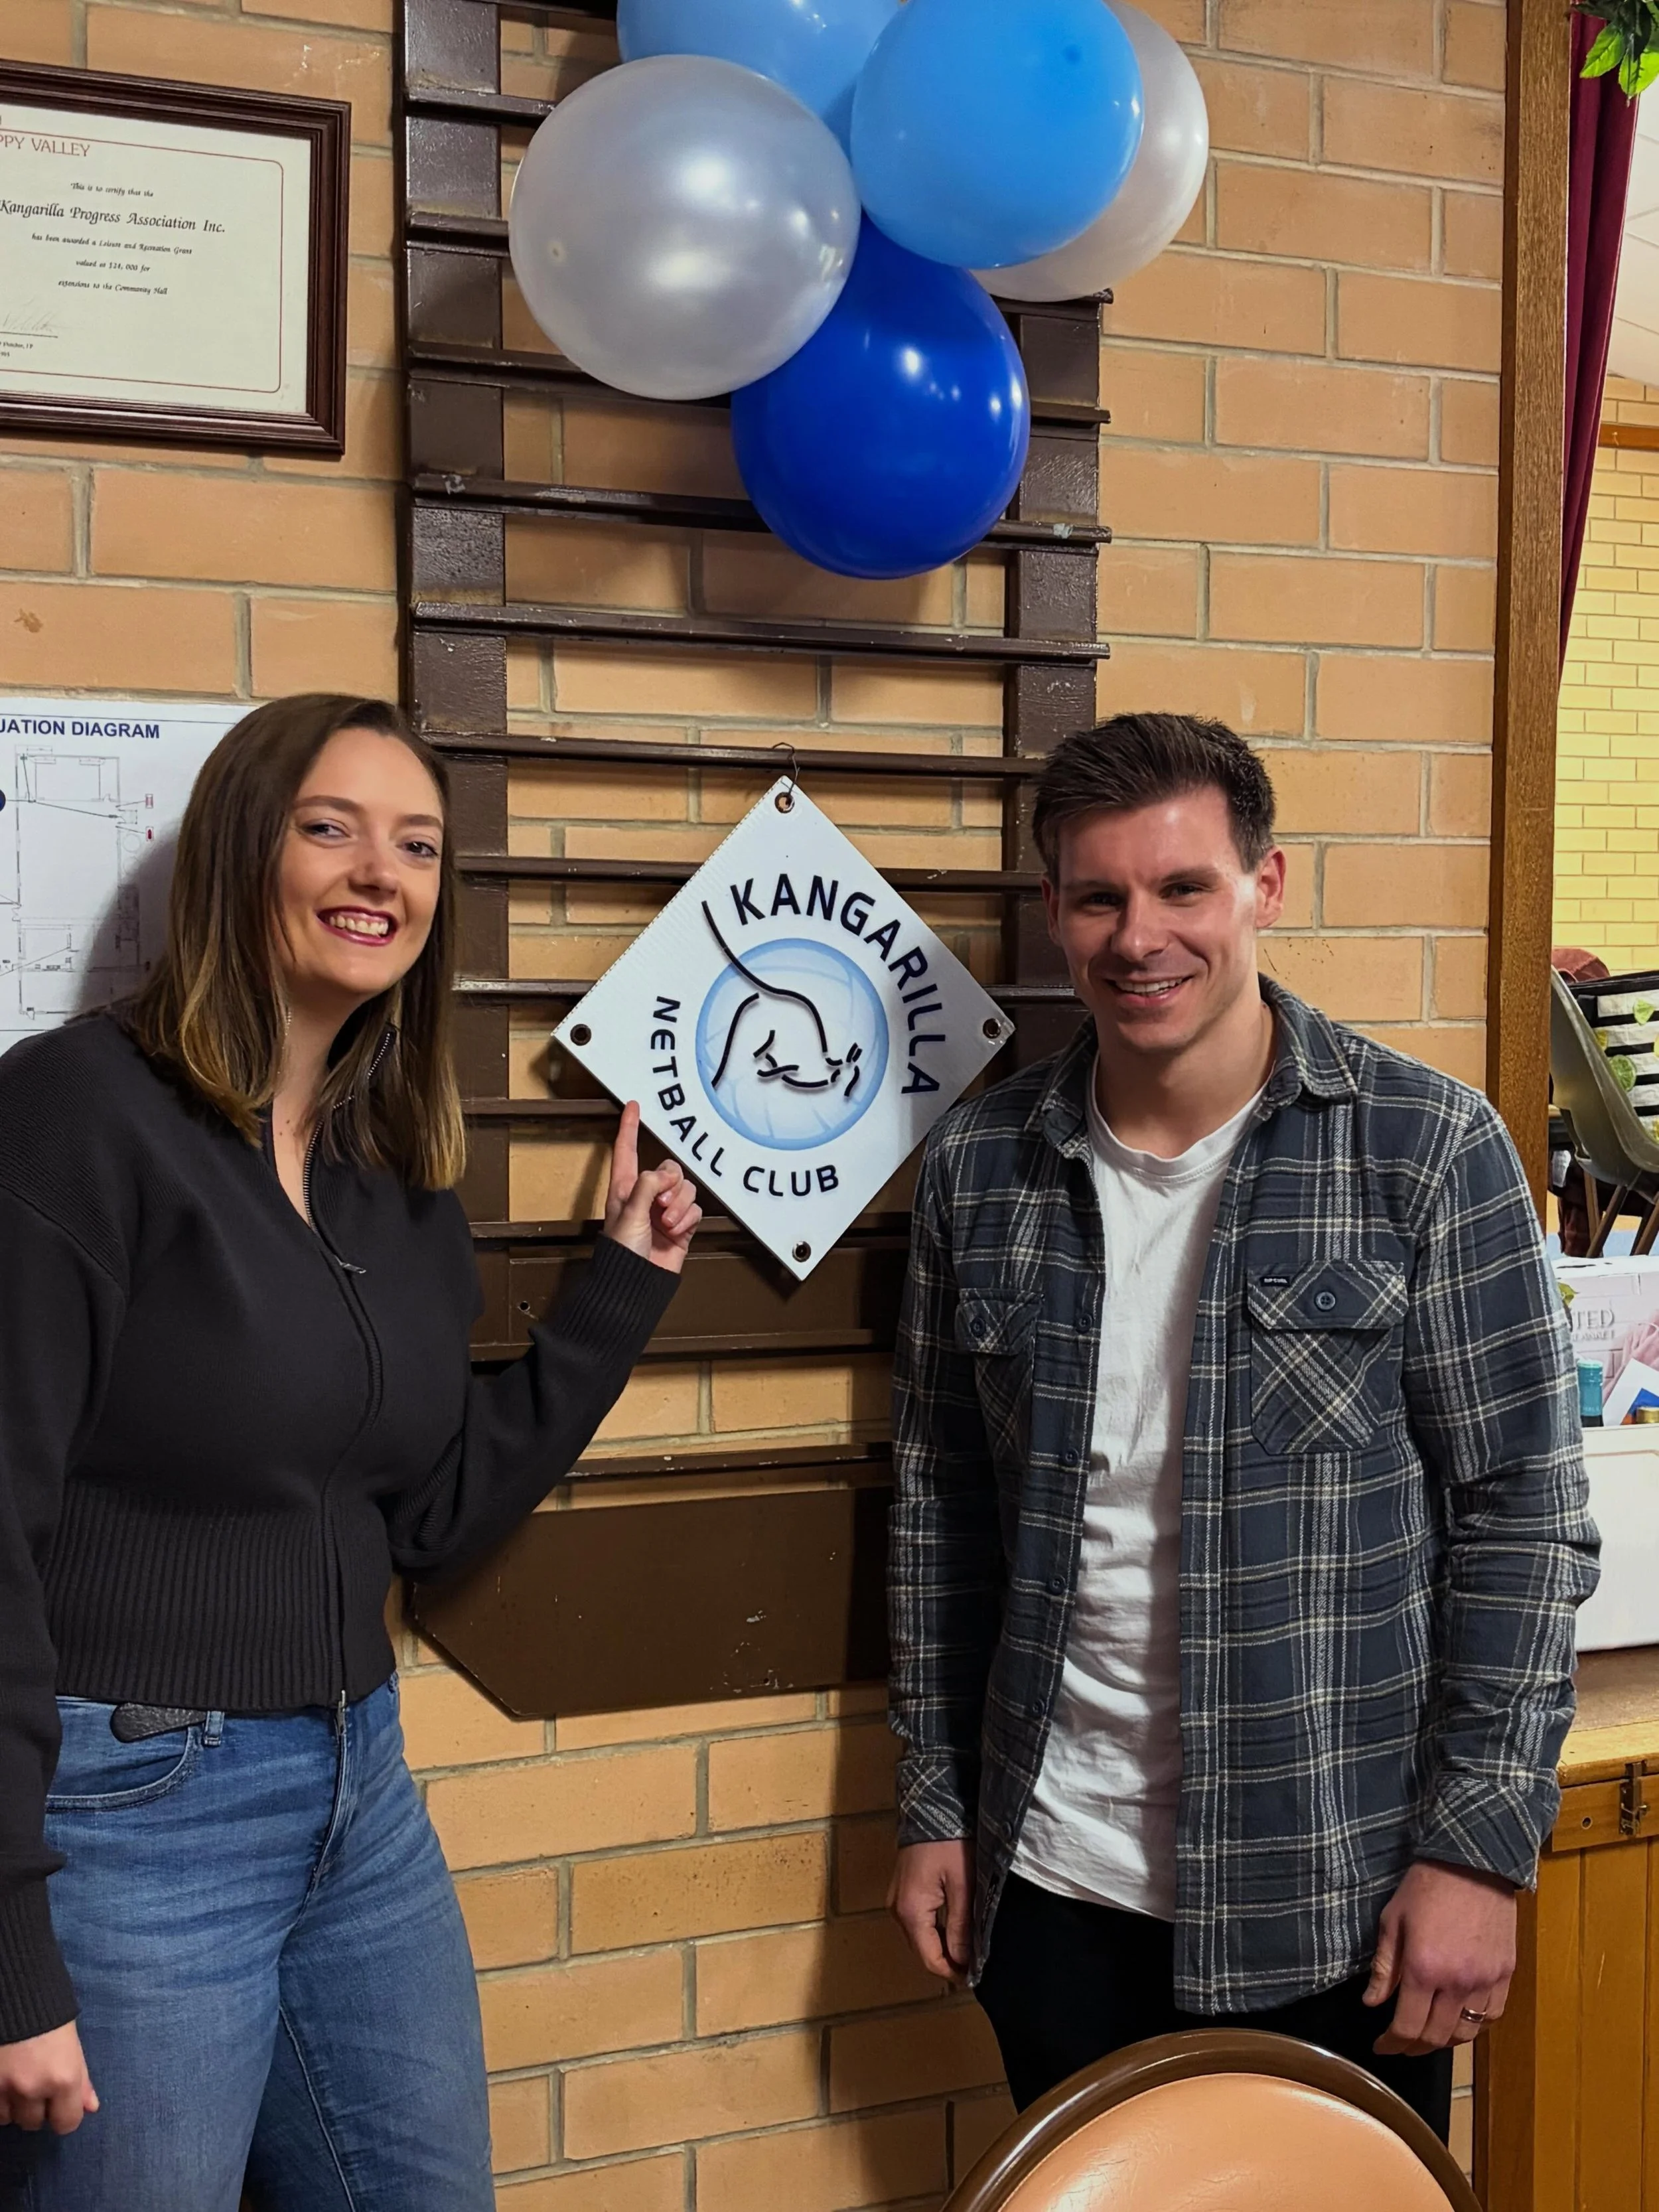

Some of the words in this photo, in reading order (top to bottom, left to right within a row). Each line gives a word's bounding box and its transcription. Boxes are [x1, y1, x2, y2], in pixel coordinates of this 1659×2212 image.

[31, 137, 90, 157] VALLEY
[106, 187, 125, 196] certify
[0, 199, 64, 218] Kangarilla
[70, 206, 121, 225] Progress
[126, 212, 196, 230] Association
[203, 220, 225, 232] Inc.
[32, 232, 42, 241] has
[72, 721, 159, 739] DIAGRAM
[730, 873, 946, 1096] KANGARILLA
[650, 995, 724, 1177] NETBALL
[743, 1164, 839, 1197] CLUB
